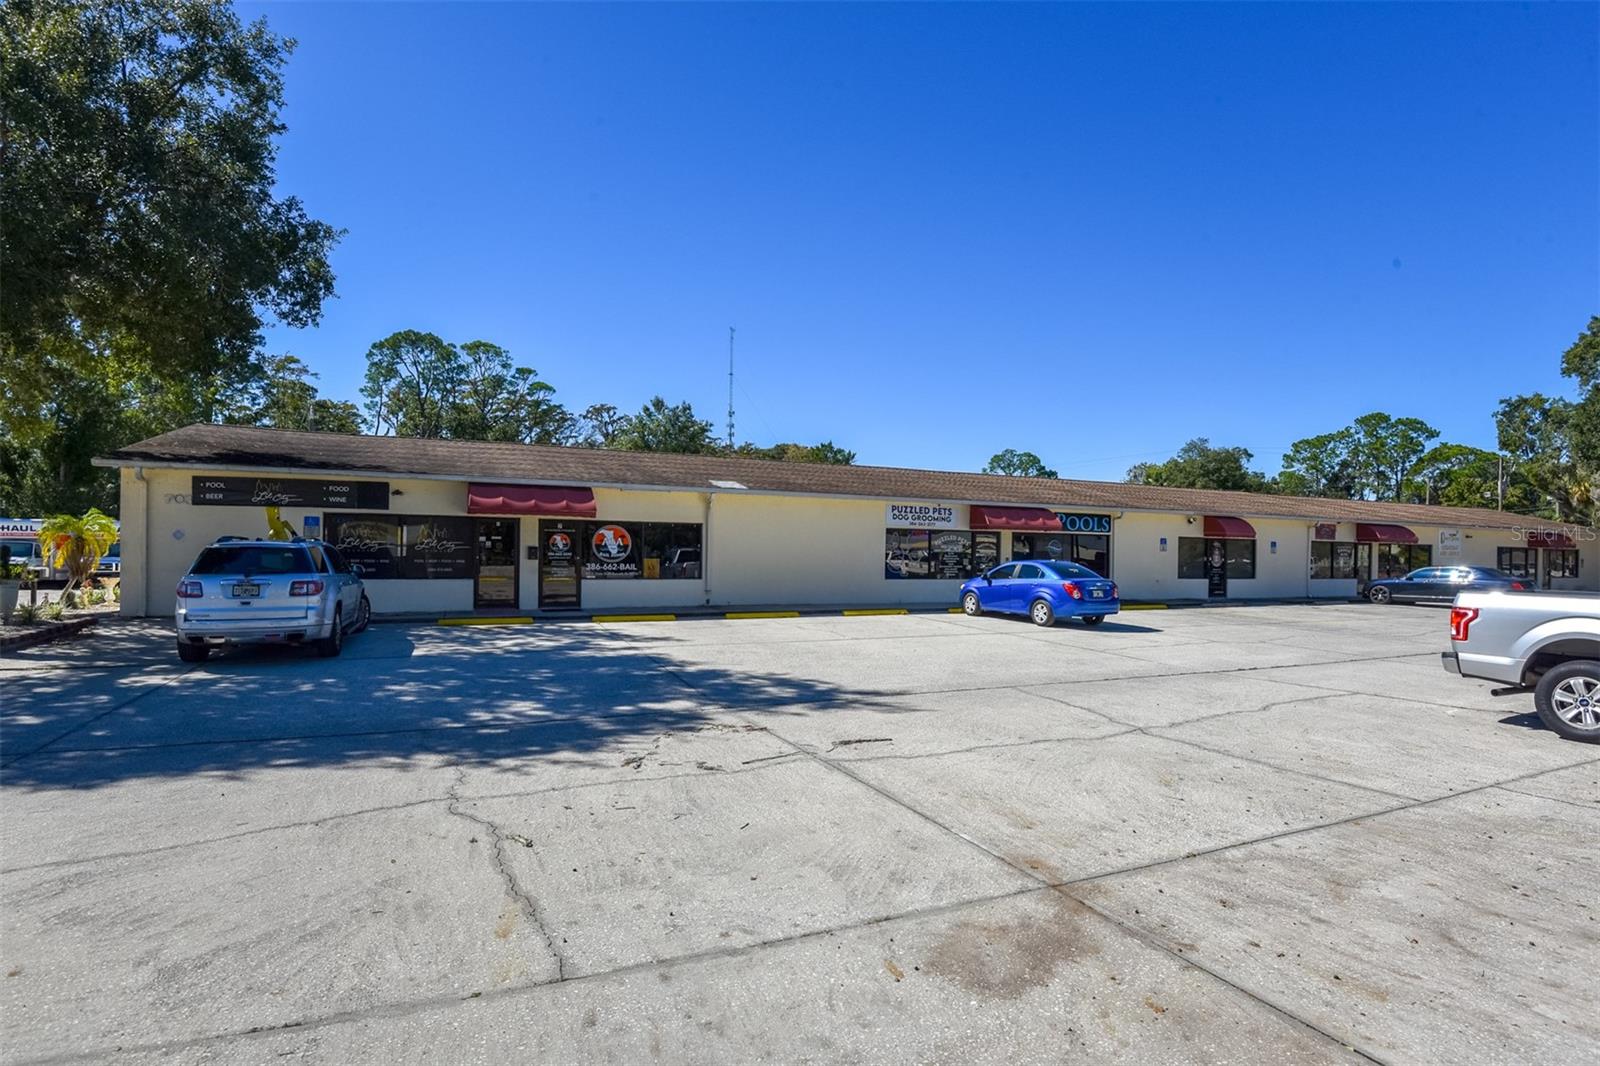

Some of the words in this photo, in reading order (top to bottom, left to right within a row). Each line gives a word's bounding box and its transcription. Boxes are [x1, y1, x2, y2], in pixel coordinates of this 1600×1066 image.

[891, 505, 931, 515] PUZZLED
[932, 507, 953, 516] PETS
[892, 513, 909, 521] DOG
[911, 514, 952, 523] GROOMING
[585, 563, 638, 571] 386-662-BAIL
